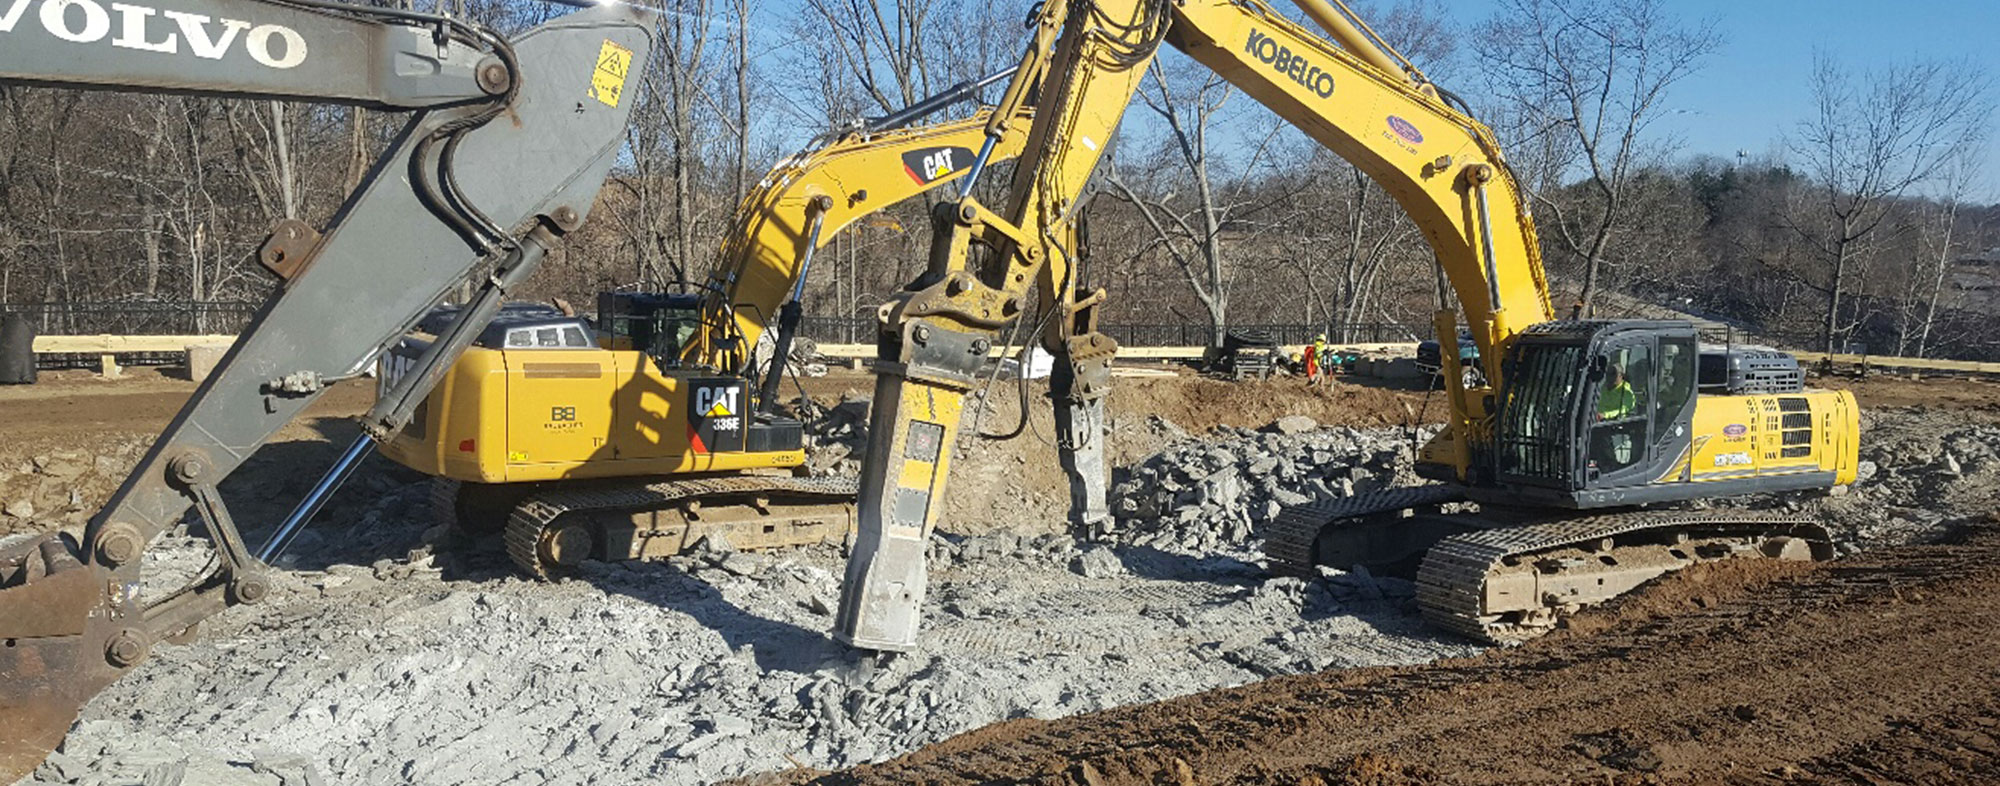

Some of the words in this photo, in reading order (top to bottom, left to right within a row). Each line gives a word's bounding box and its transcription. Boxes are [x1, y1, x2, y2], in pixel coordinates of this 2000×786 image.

[1245, 28, 1334, 99] KOBELCO
[923, 148, 954, 180] CAT
[696, 386, 740, 417] CAT
[713, 417, 740, 431] 336E
